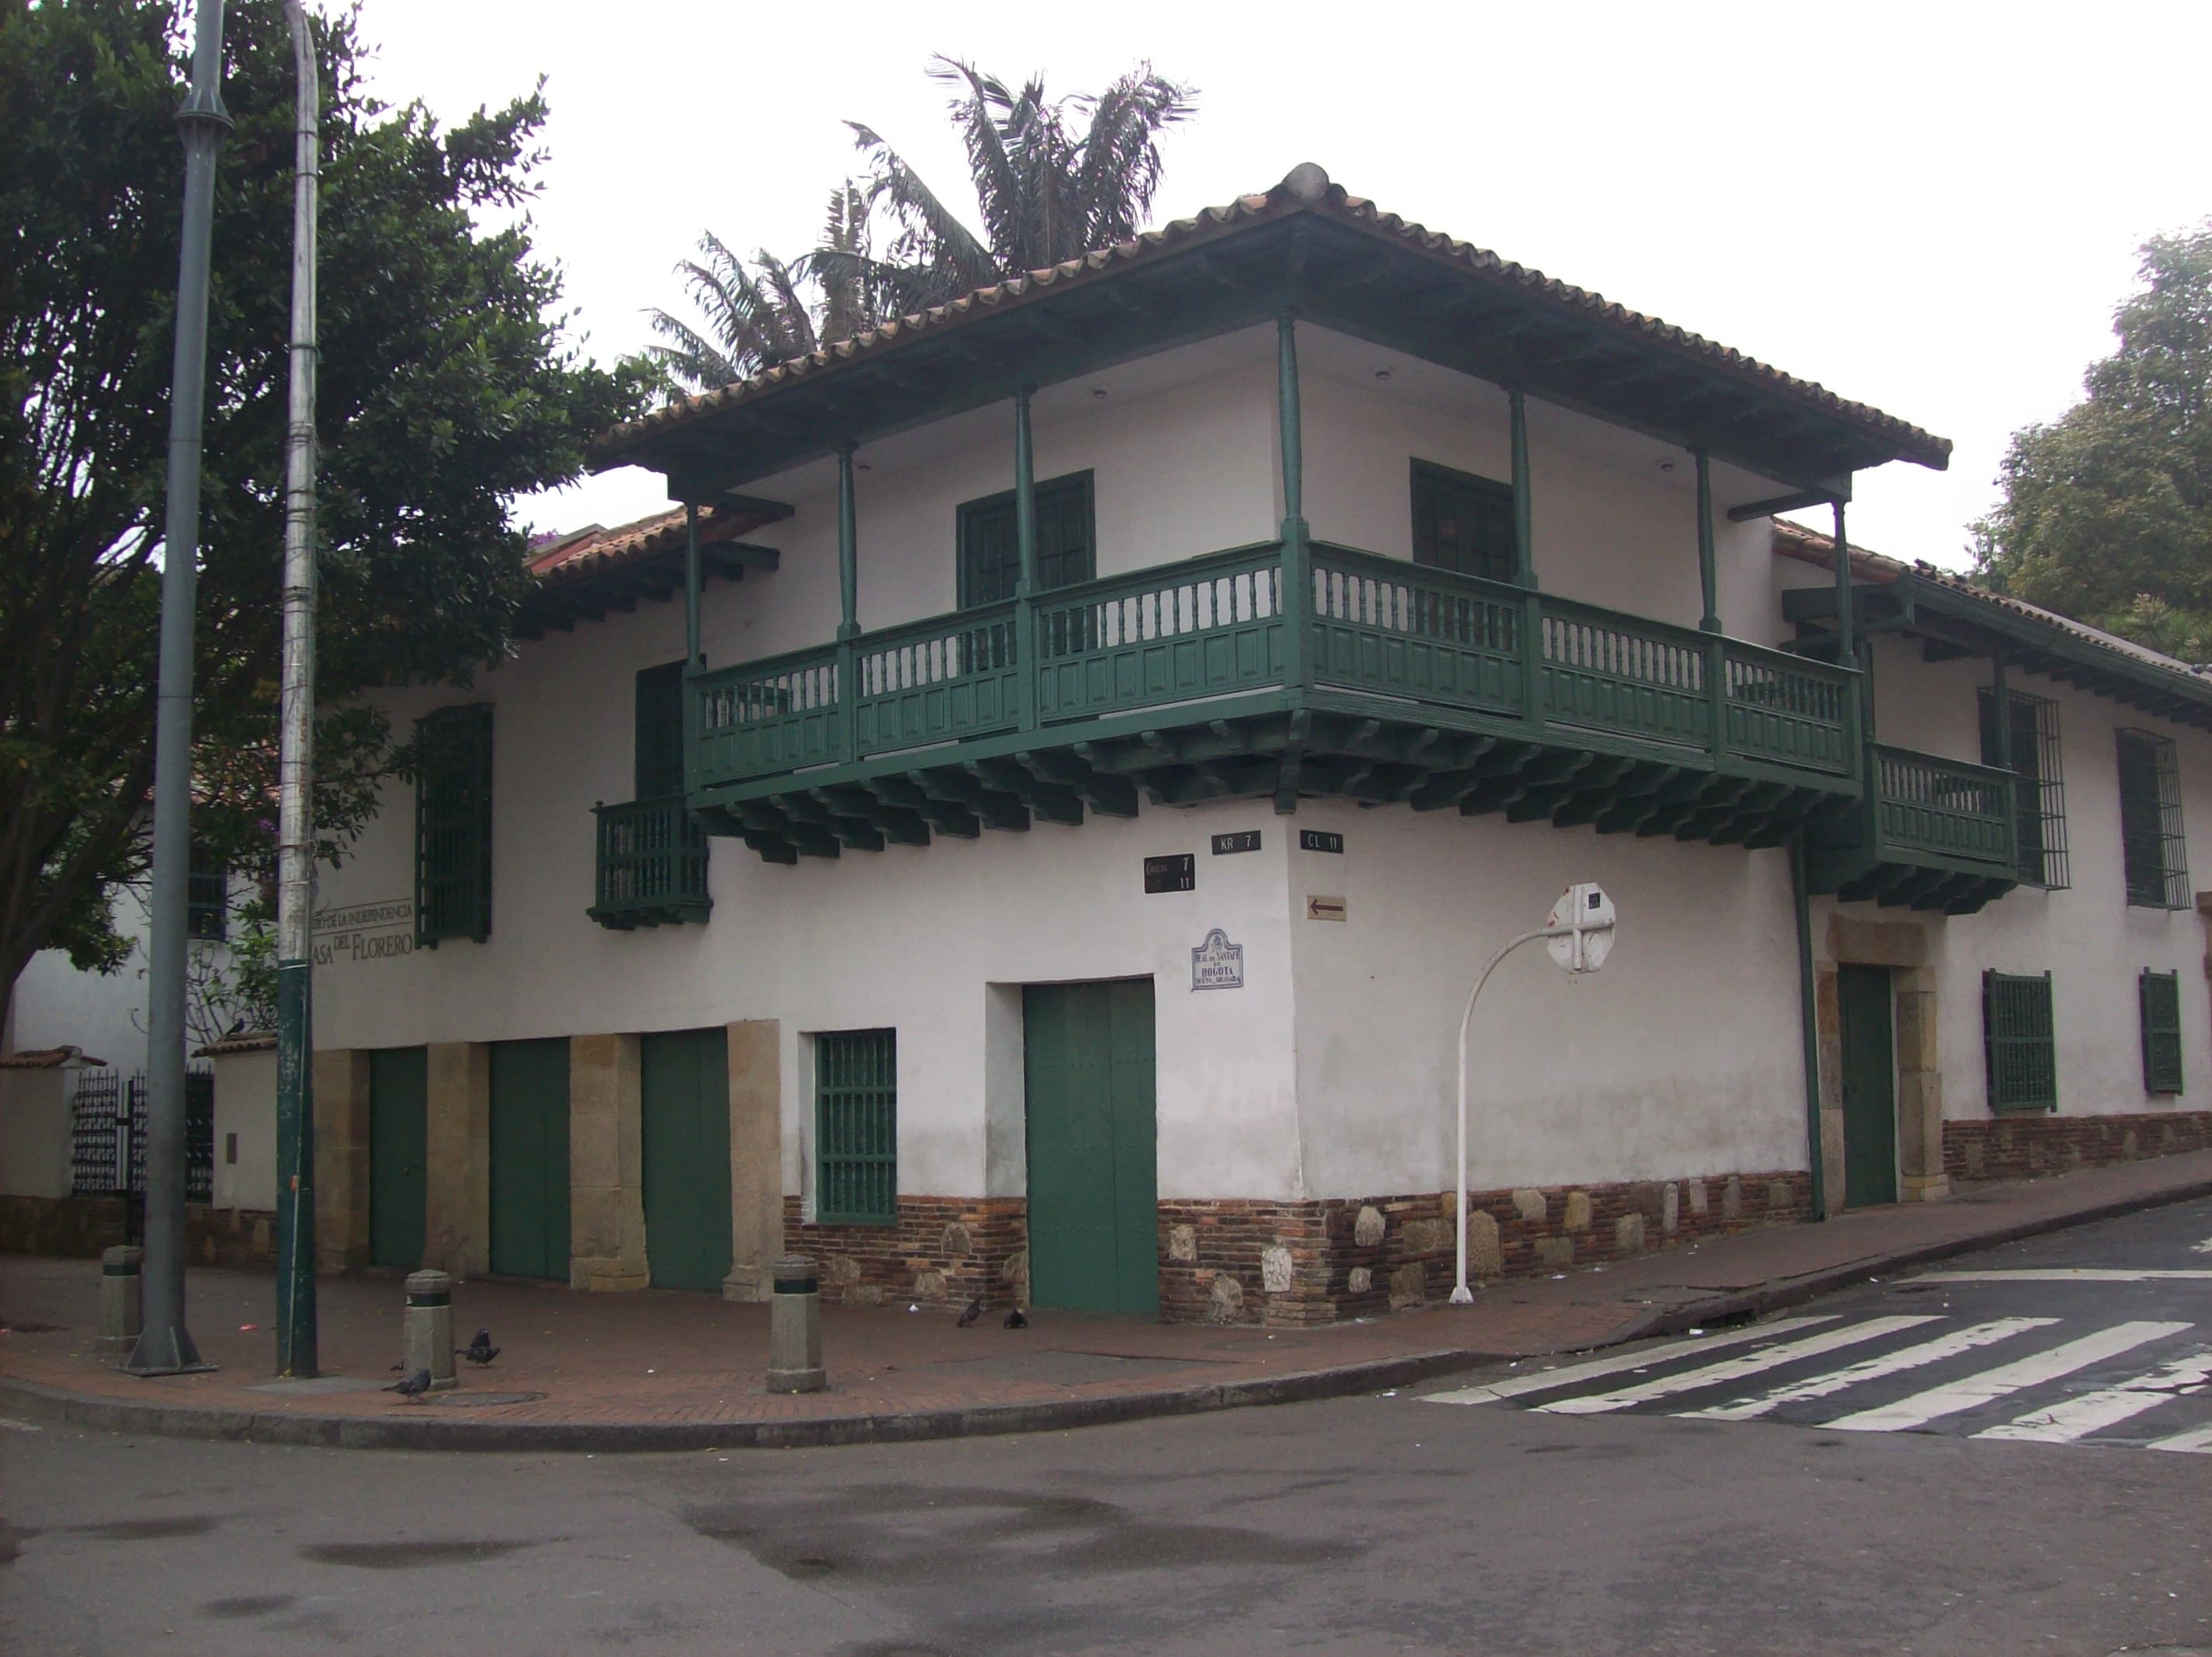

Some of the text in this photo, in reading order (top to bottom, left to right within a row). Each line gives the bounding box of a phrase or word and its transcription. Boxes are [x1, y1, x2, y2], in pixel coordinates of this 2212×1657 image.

[1221, 835, 1252, 851] KR 7
[1307, 833, 1337, 849] CL 11
[1182, 856, 1189, 871] 7
[1180, 877, 1190, 889] 11
[312, 933, 413, 964] ASA DEL FLORERO
[1202, 967, 1233, 977] BOGOTA
